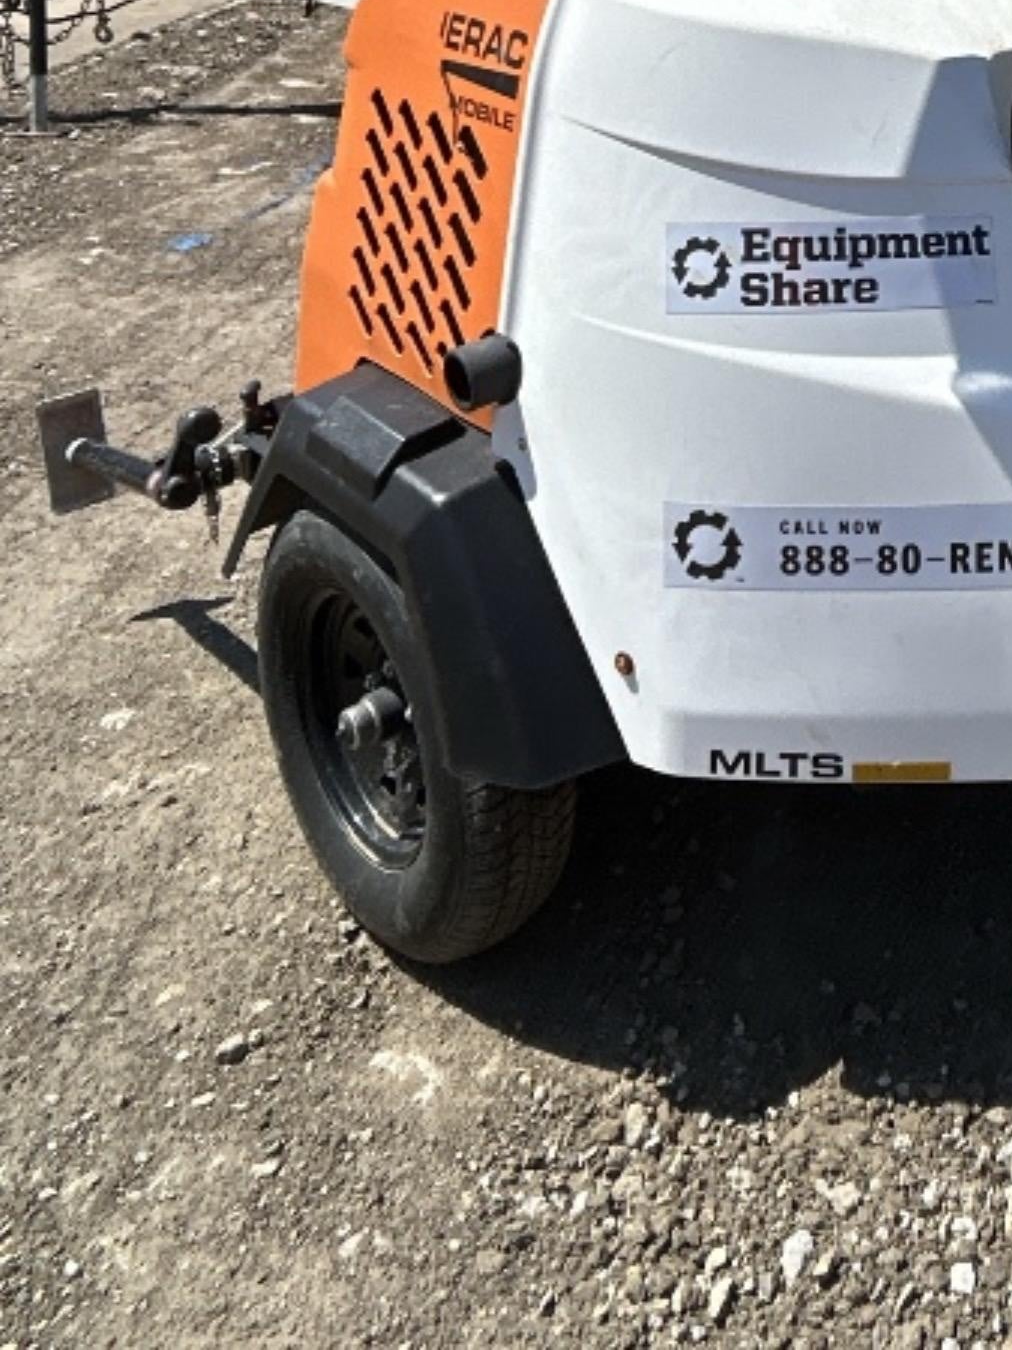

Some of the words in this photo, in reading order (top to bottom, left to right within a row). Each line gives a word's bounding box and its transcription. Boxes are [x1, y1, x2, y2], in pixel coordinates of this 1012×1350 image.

[440, 11, 528, 69] ERAC
[740, 224, 991, 270] Equipment
[740, 272, 879, 307] Share
[779, 520, 829, 535] CALL
[839, 520, 883, 535] NOW
[710, 749, 844, 778] MLTS
